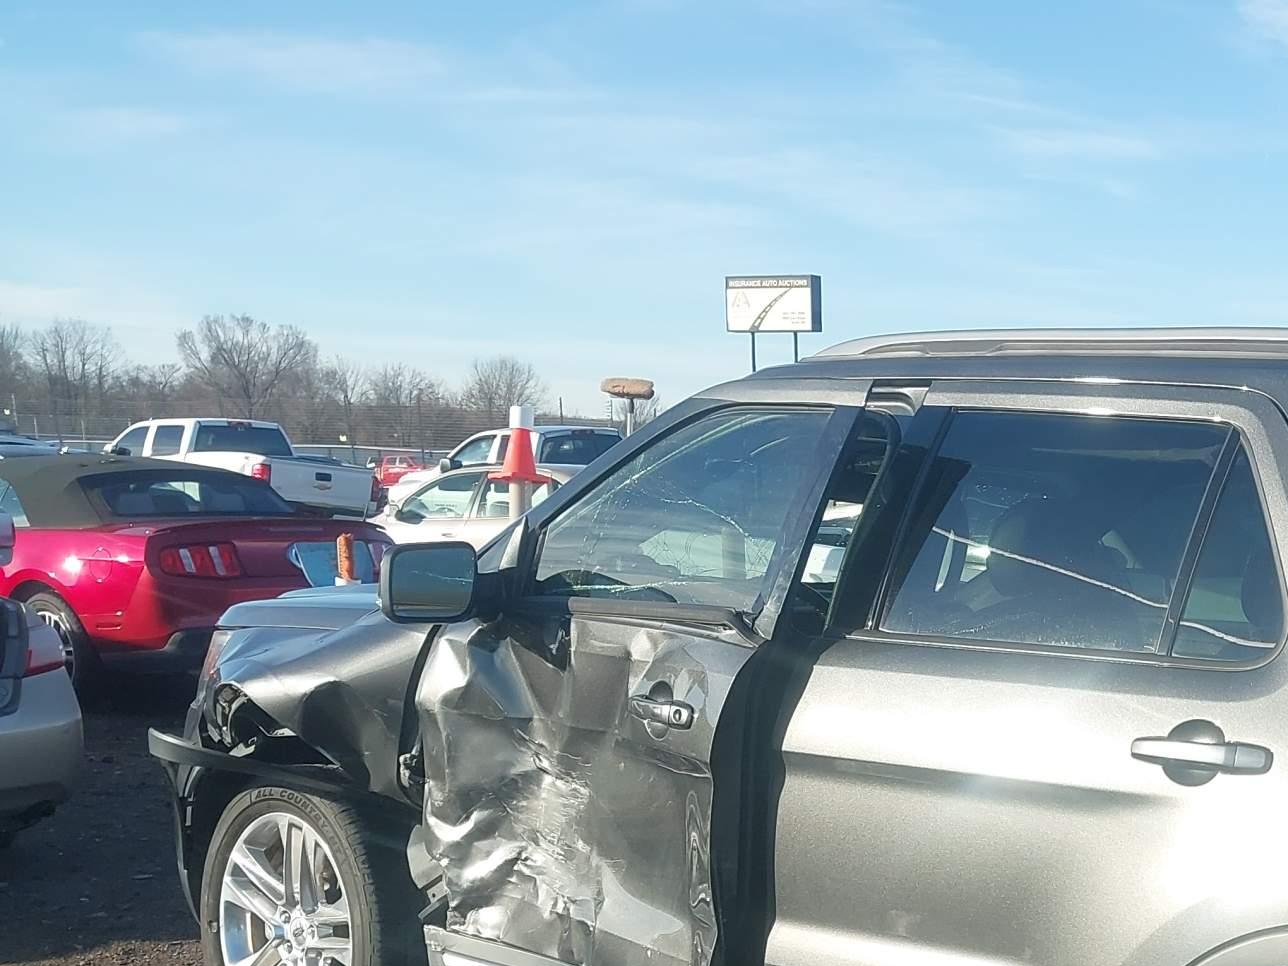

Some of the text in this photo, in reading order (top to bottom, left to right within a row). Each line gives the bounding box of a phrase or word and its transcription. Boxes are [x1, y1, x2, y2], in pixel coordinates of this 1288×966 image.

[729, 279, 808, 288] INSURANCE AUTO AUCTIONS
[255, 789, 329, 830] ALL COUNTRY
